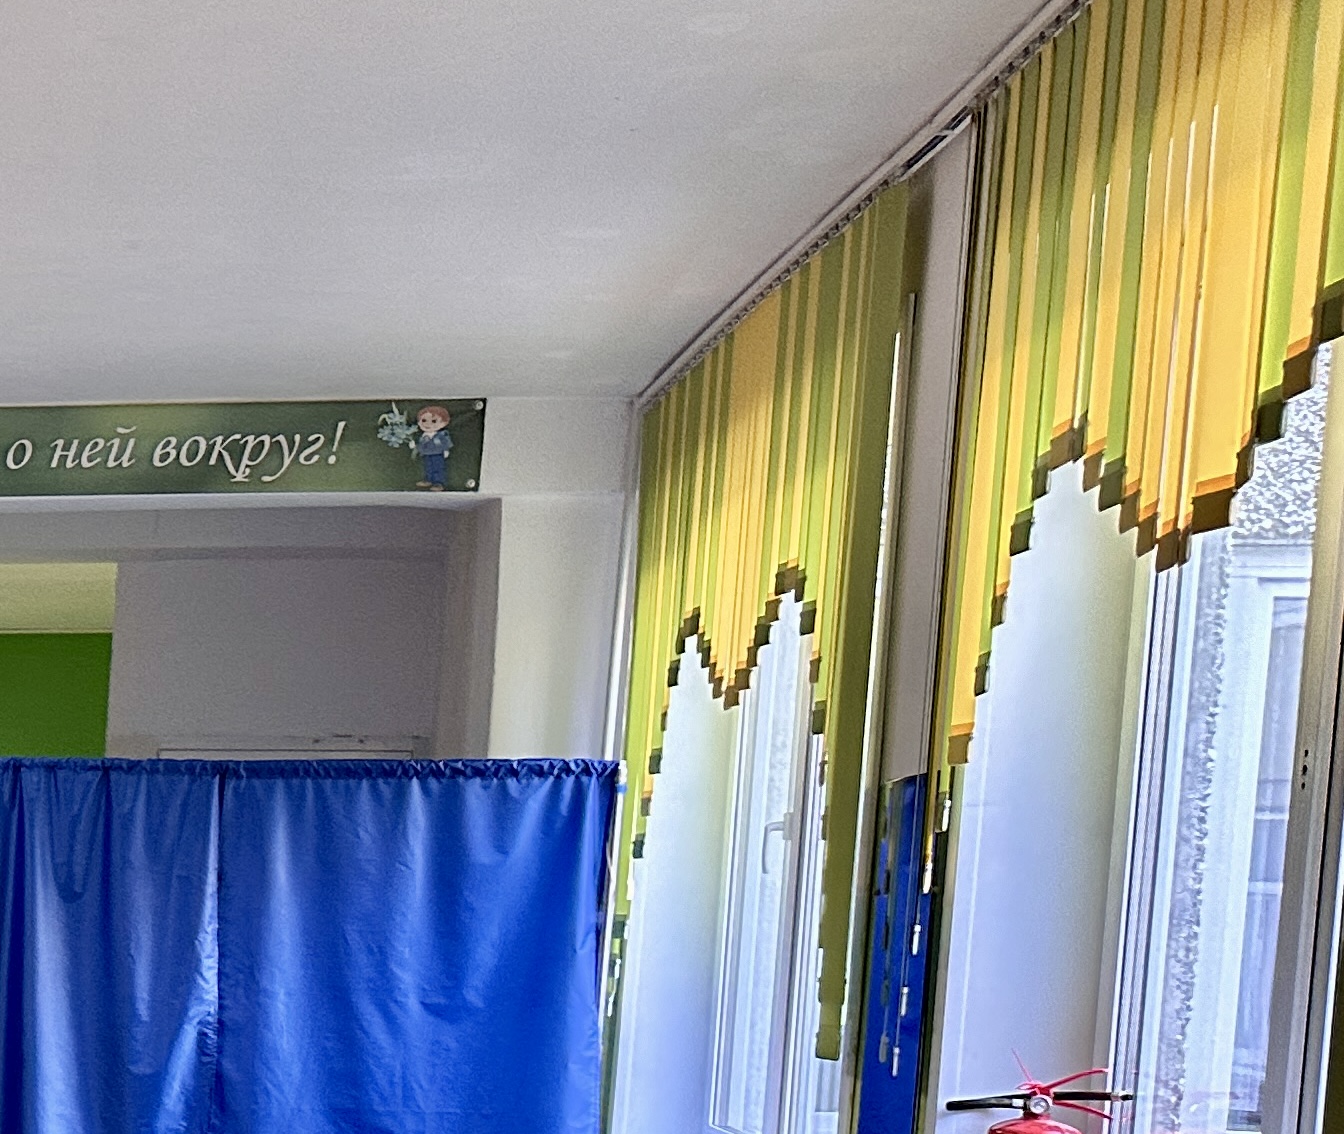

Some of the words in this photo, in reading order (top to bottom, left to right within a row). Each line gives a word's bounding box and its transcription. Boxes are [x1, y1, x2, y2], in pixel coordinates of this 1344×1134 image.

[6, 437, 34, 470] о
[49, 424, 137, 470] ней
[151, 420, 348, 483] вокруг!
